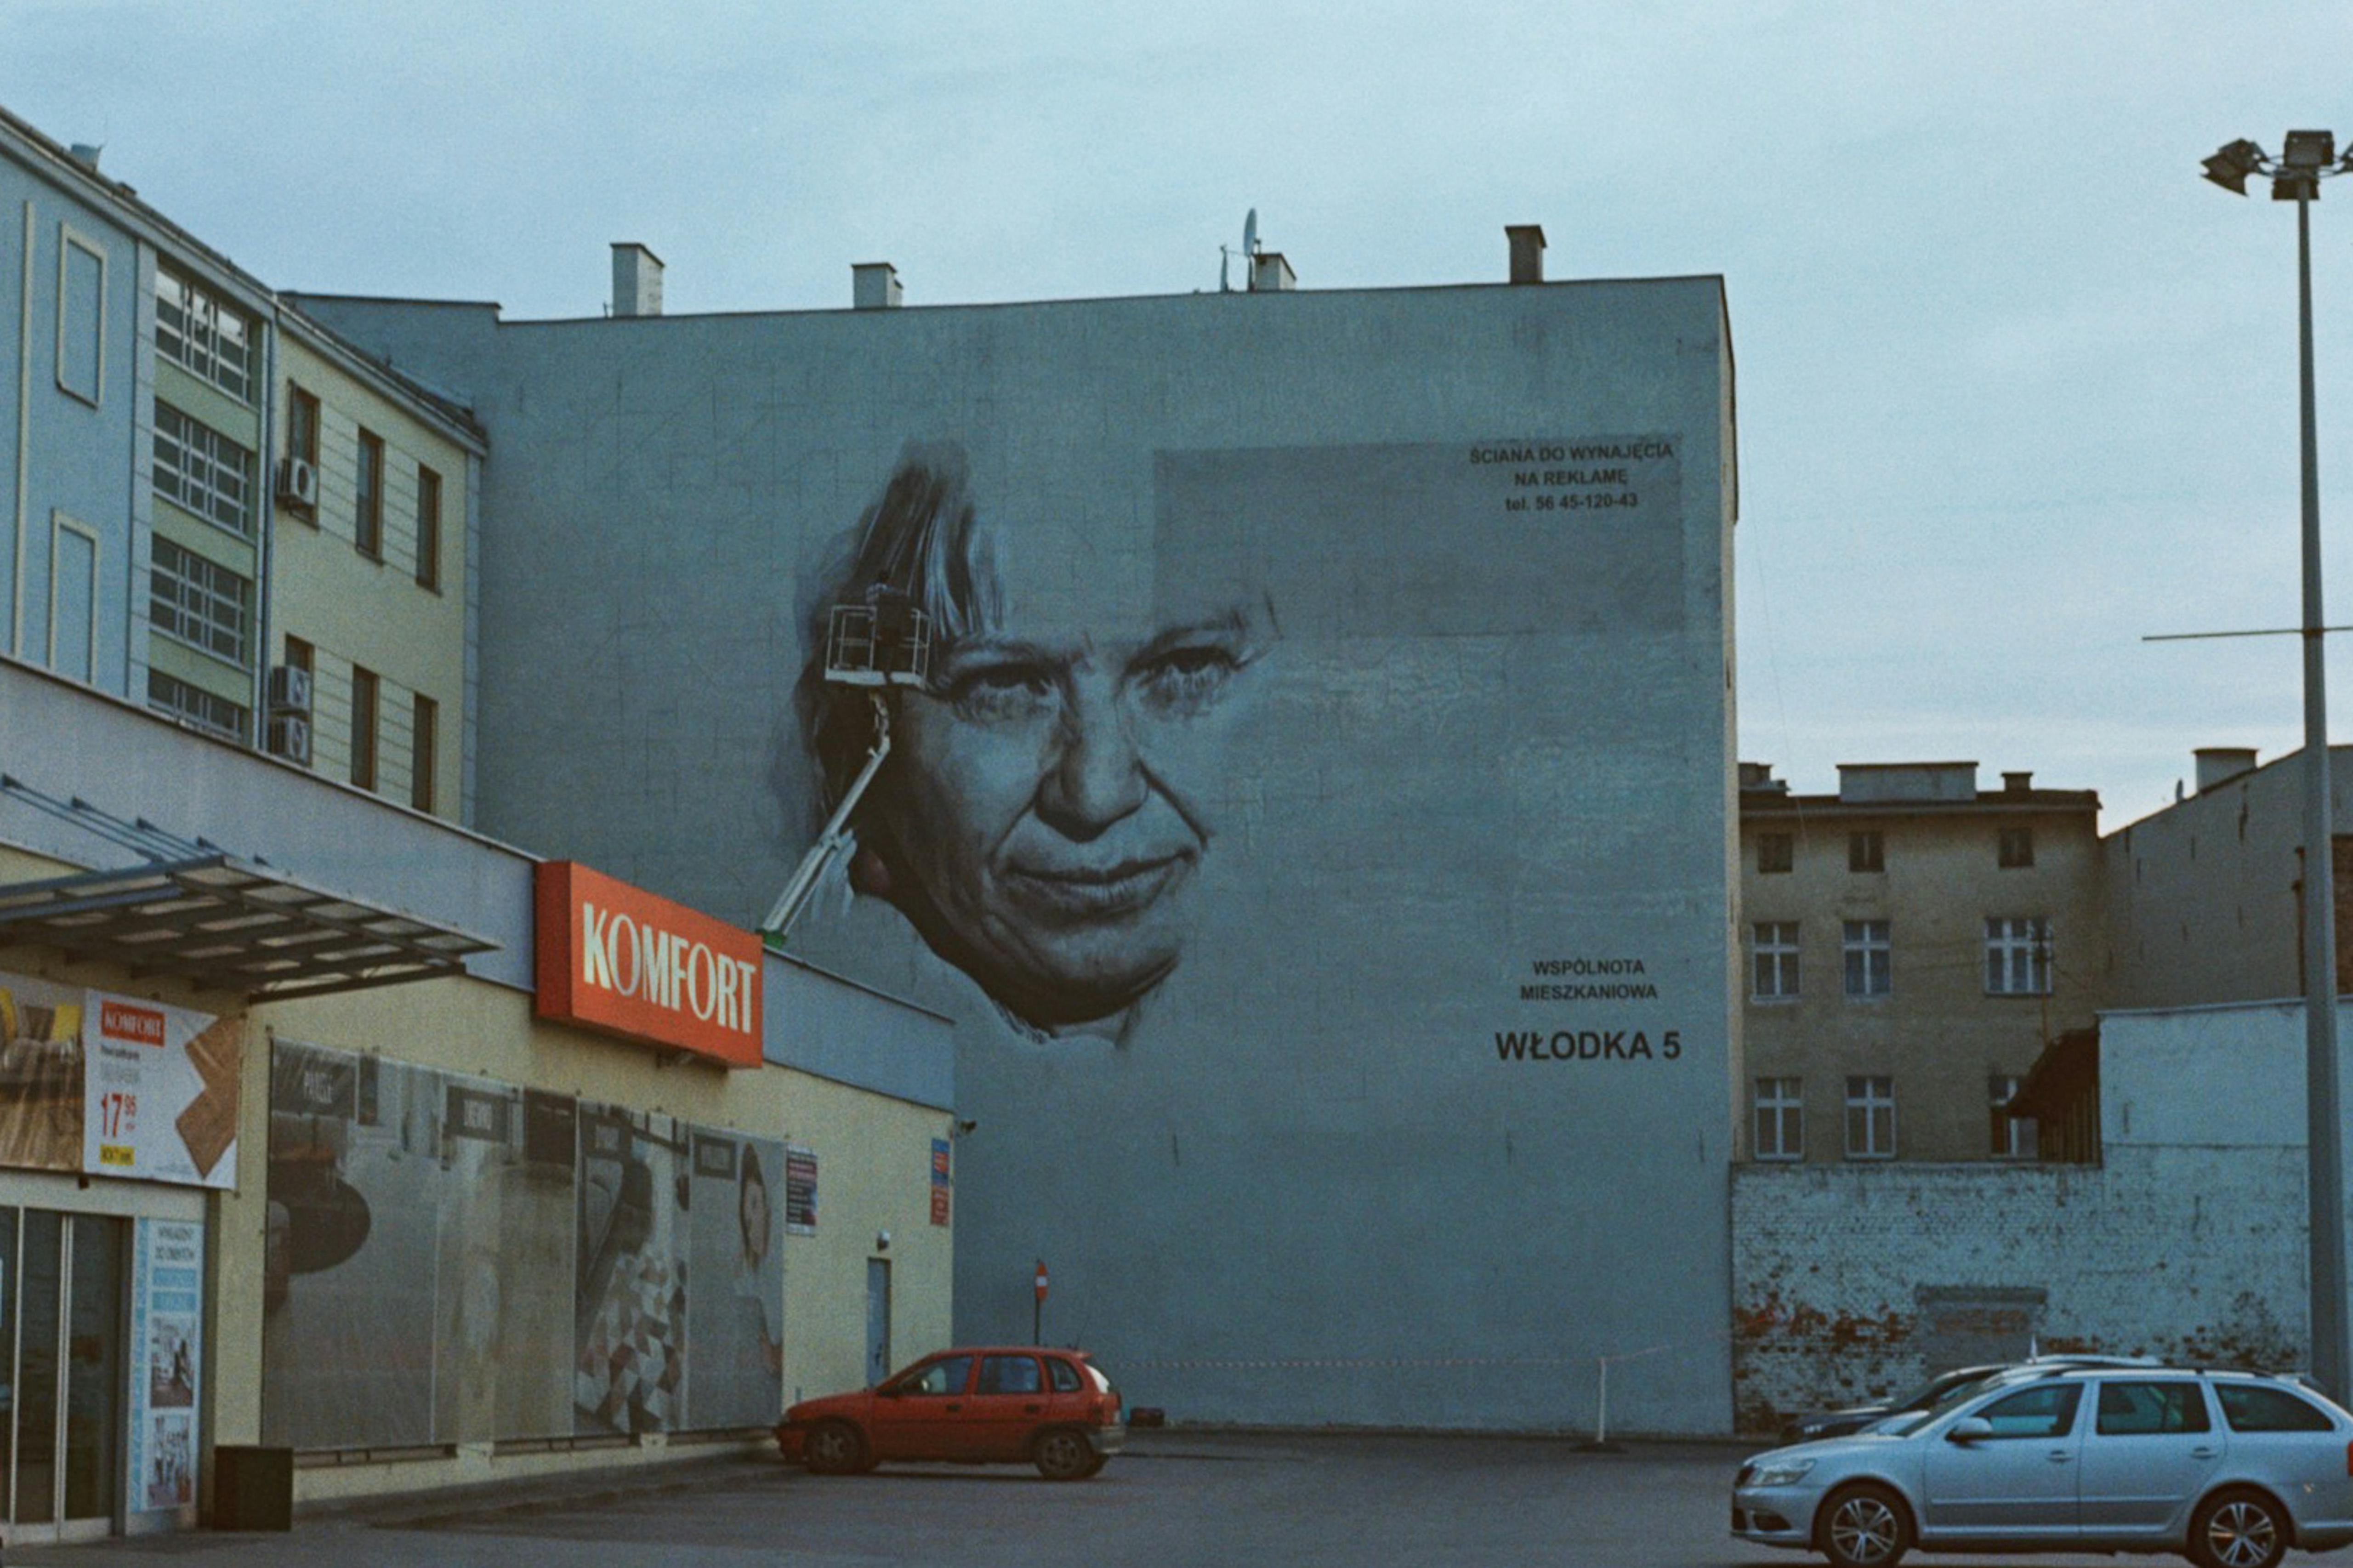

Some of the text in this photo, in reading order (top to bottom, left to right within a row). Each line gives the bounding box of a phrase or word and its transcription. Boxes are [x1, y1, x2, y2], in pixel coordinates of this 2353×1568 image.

[1471, 444, 1535, 464] ŚCIANA
[1540, 447, 1564, 461] DO
[1516, 468, 1628, 486] NA REKLAMĘ
[1506, 497, 1530, 511] tel.
[1536, 495, 1554, 510] 56
[583, 902, 756, 1034] KOMFORT
[1533, 958, 1645, 975] WSPÓLNOTA
[1521, 984, 1658, 1000] MIESZKANIOWA
[1495, 1031, 1682, 1060] WŁODKA 5
